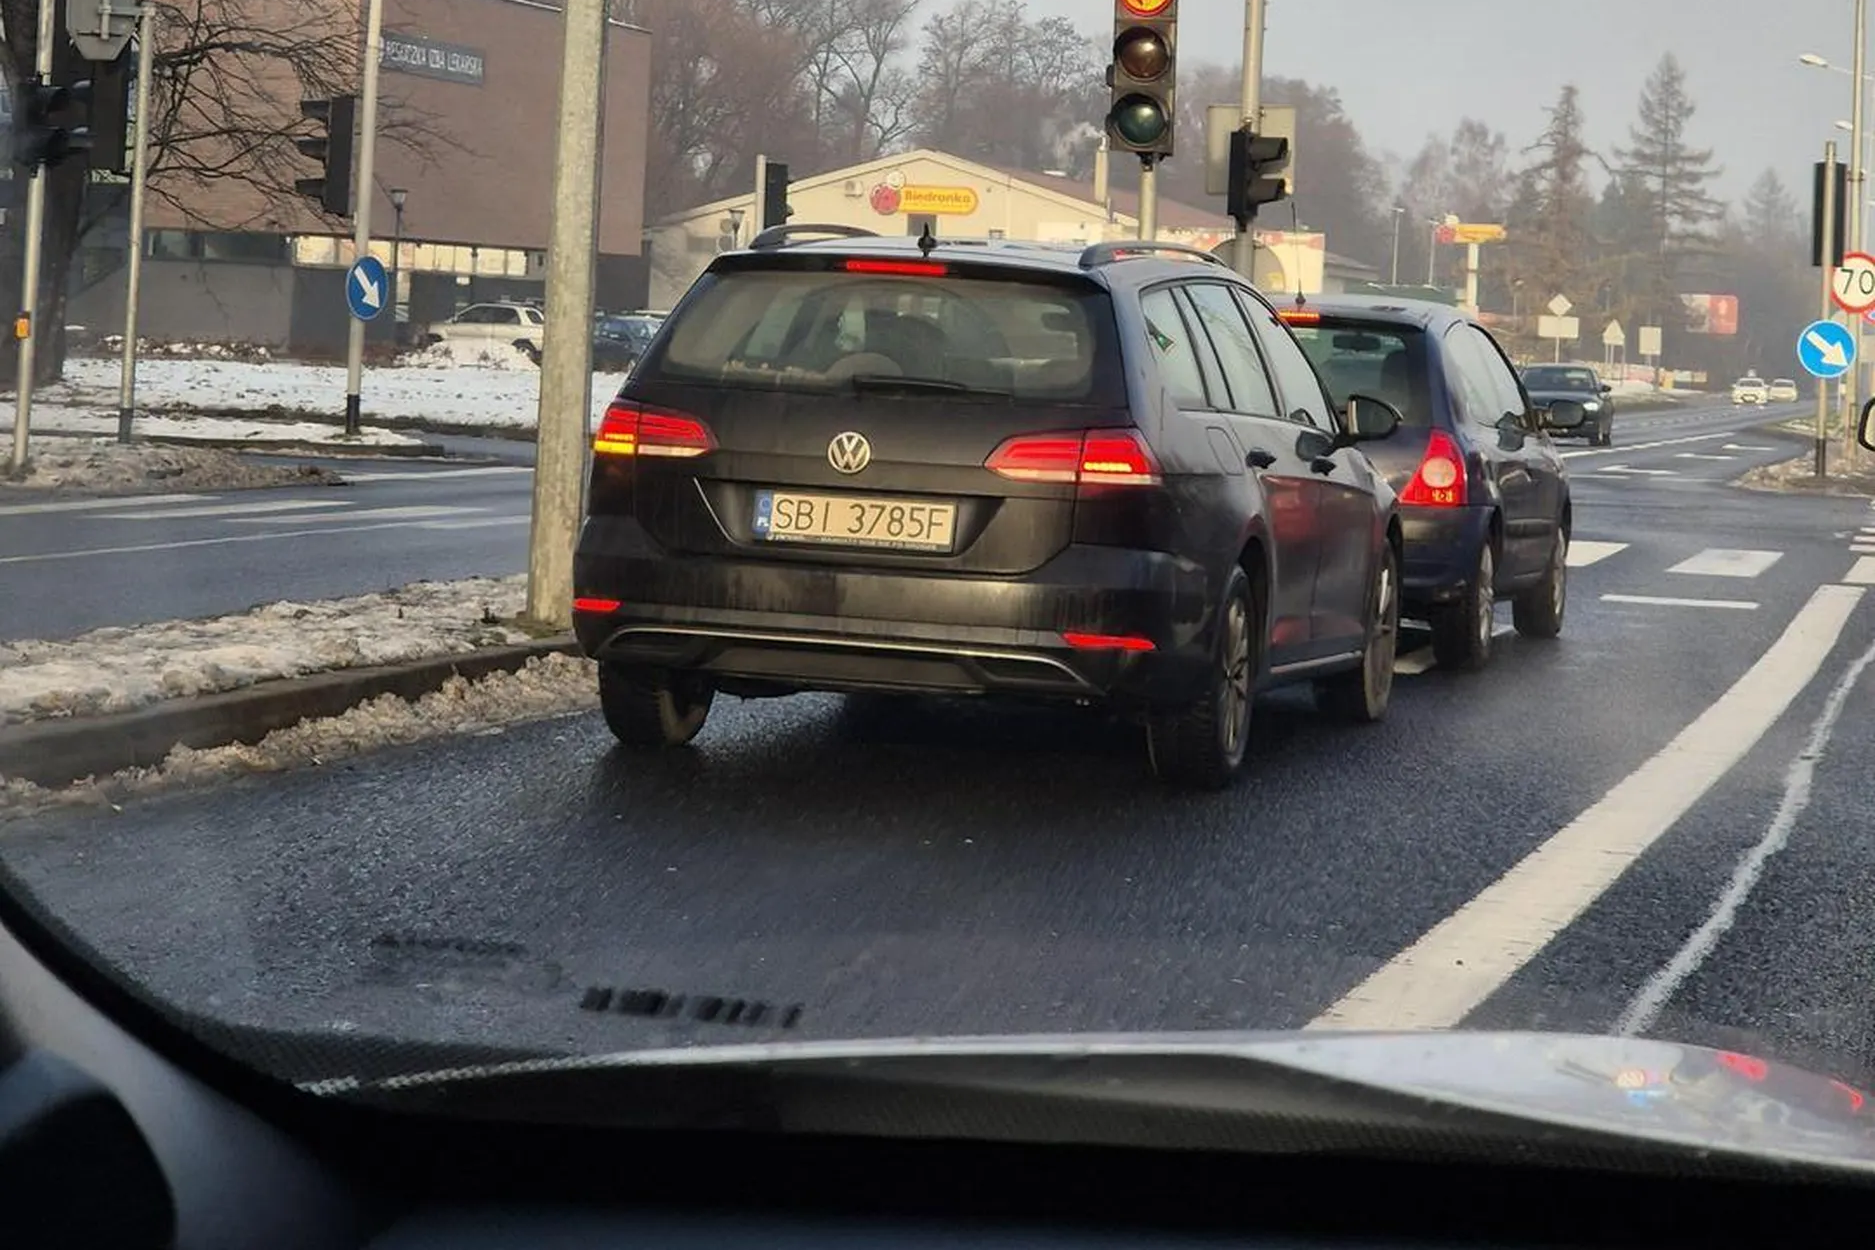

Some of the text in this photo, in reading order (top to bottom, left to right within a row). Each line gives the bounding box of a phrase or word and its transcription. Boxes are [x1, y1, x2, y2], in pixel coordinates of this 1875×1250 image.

[904, 190, 971, 203] Biedronka
[1841, 268, 1875, 295] 70
[775, 498, 949, 540] SBI 3785F
